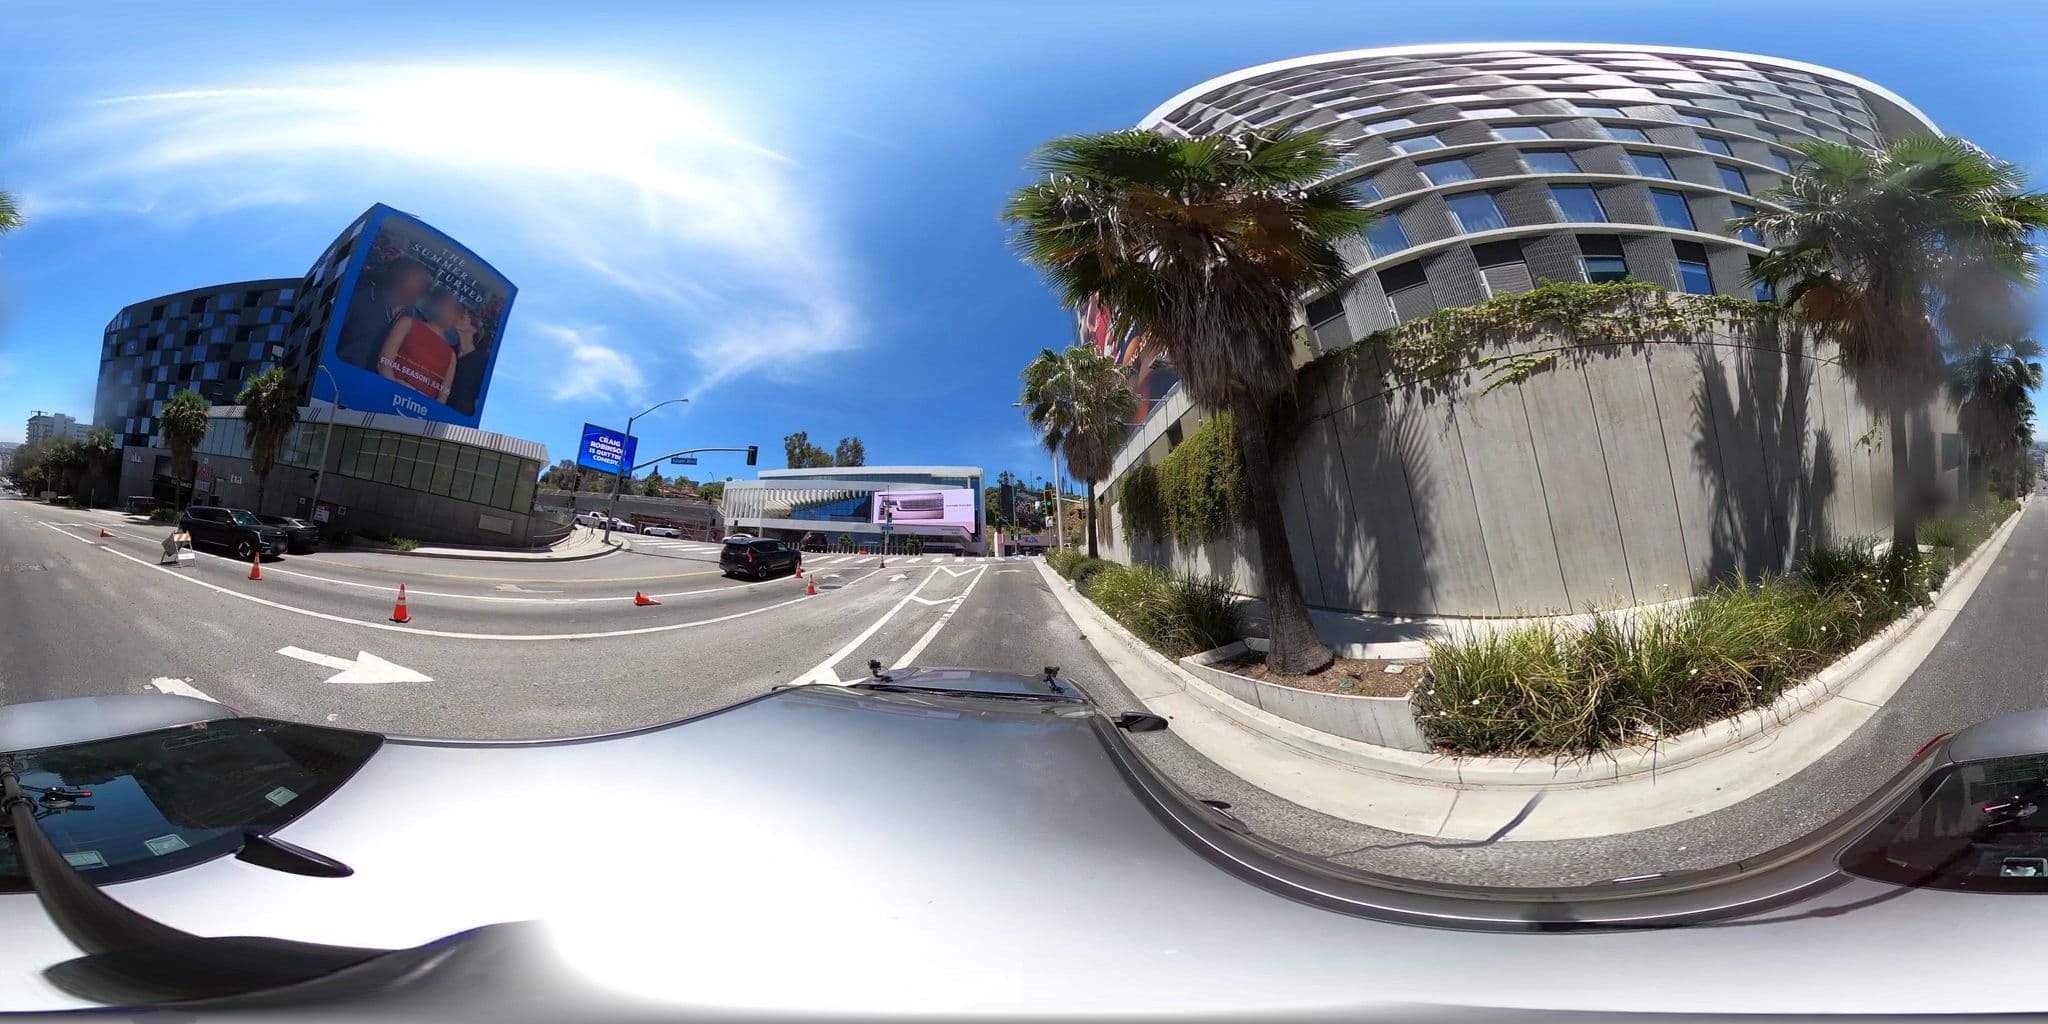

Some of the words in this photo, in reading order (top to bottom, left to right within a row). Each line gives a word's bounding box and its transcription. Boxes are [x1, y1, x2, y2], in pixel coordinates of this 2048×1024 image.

[411, 242, 469, 281] SUMMER
[441, 247, 465, 267] THE
[437, 268, 483, 303] TURNED
[380, 356, 402, 372] FINAL
[401, 366, 429, 384] SEASON
[392, 393, 428, 416] prime
[598, 436, 621, 447] CRAIG
